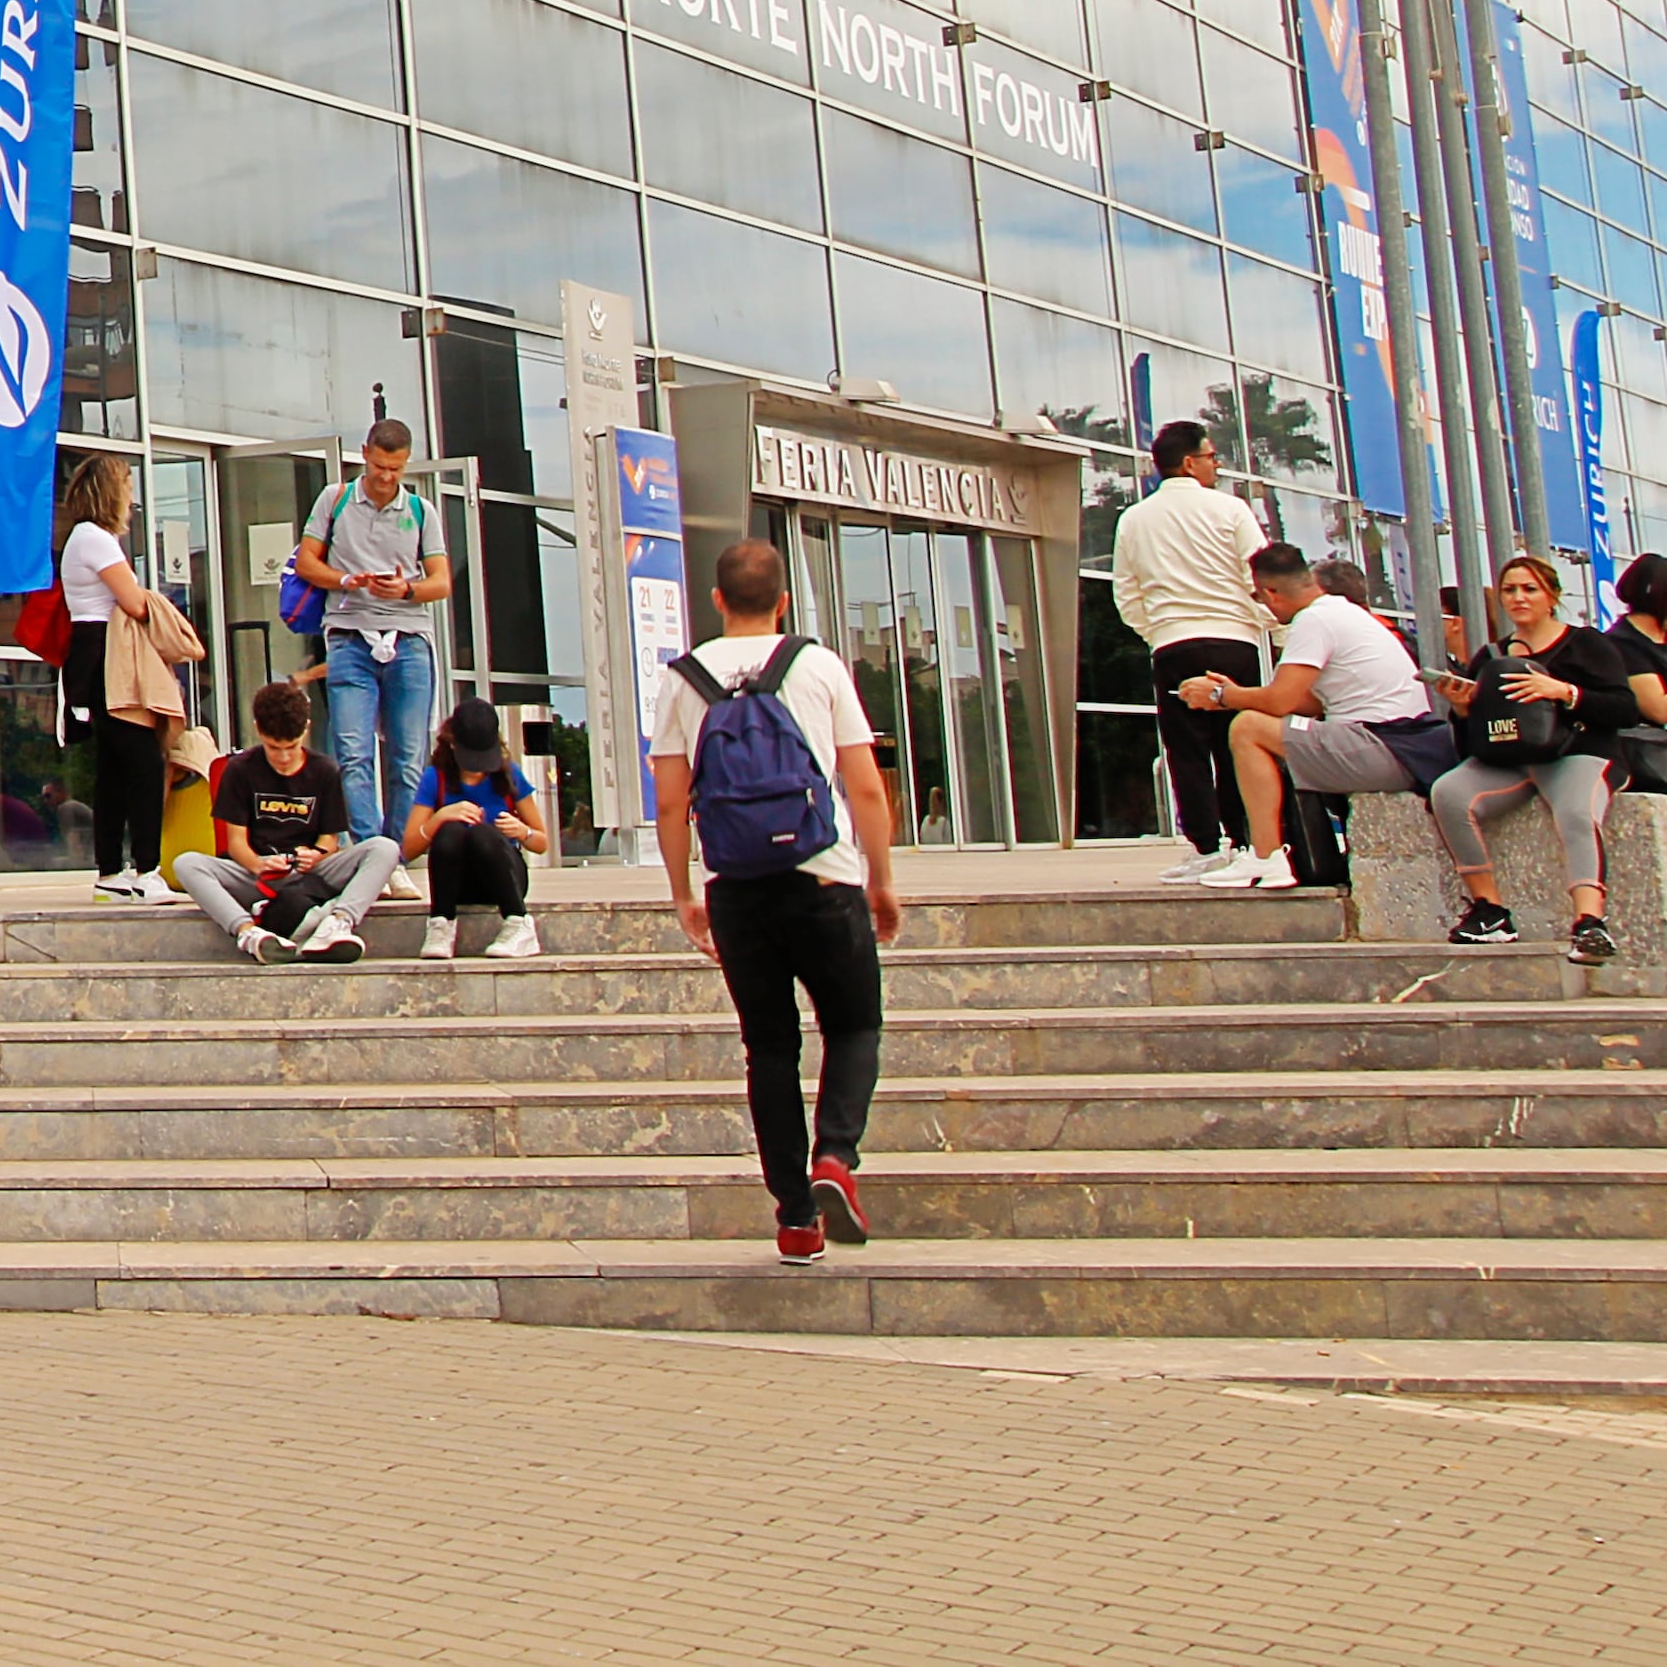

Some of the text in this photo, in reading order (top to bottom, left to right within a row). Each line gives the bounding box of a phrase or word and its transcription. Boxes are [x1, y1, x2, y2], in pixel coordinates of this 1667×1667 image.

[974, 62, 1099, 169] FORUM
[1337, 220, 1384, 287] RUNNE
[1360, 284, 1386, 342] EXP
[1532, 392, 1559, 433] RICH
[754, 424, 857, 499] FERIA
[863, 447, 1007, 522] VALENCIA
[582, 425, 606, 634] VALENCIA
[638, 586, 676, 611] 21 22
[597, 661, 616, 789] FERIA
[1487, 717, 1518, 735] LOVE
